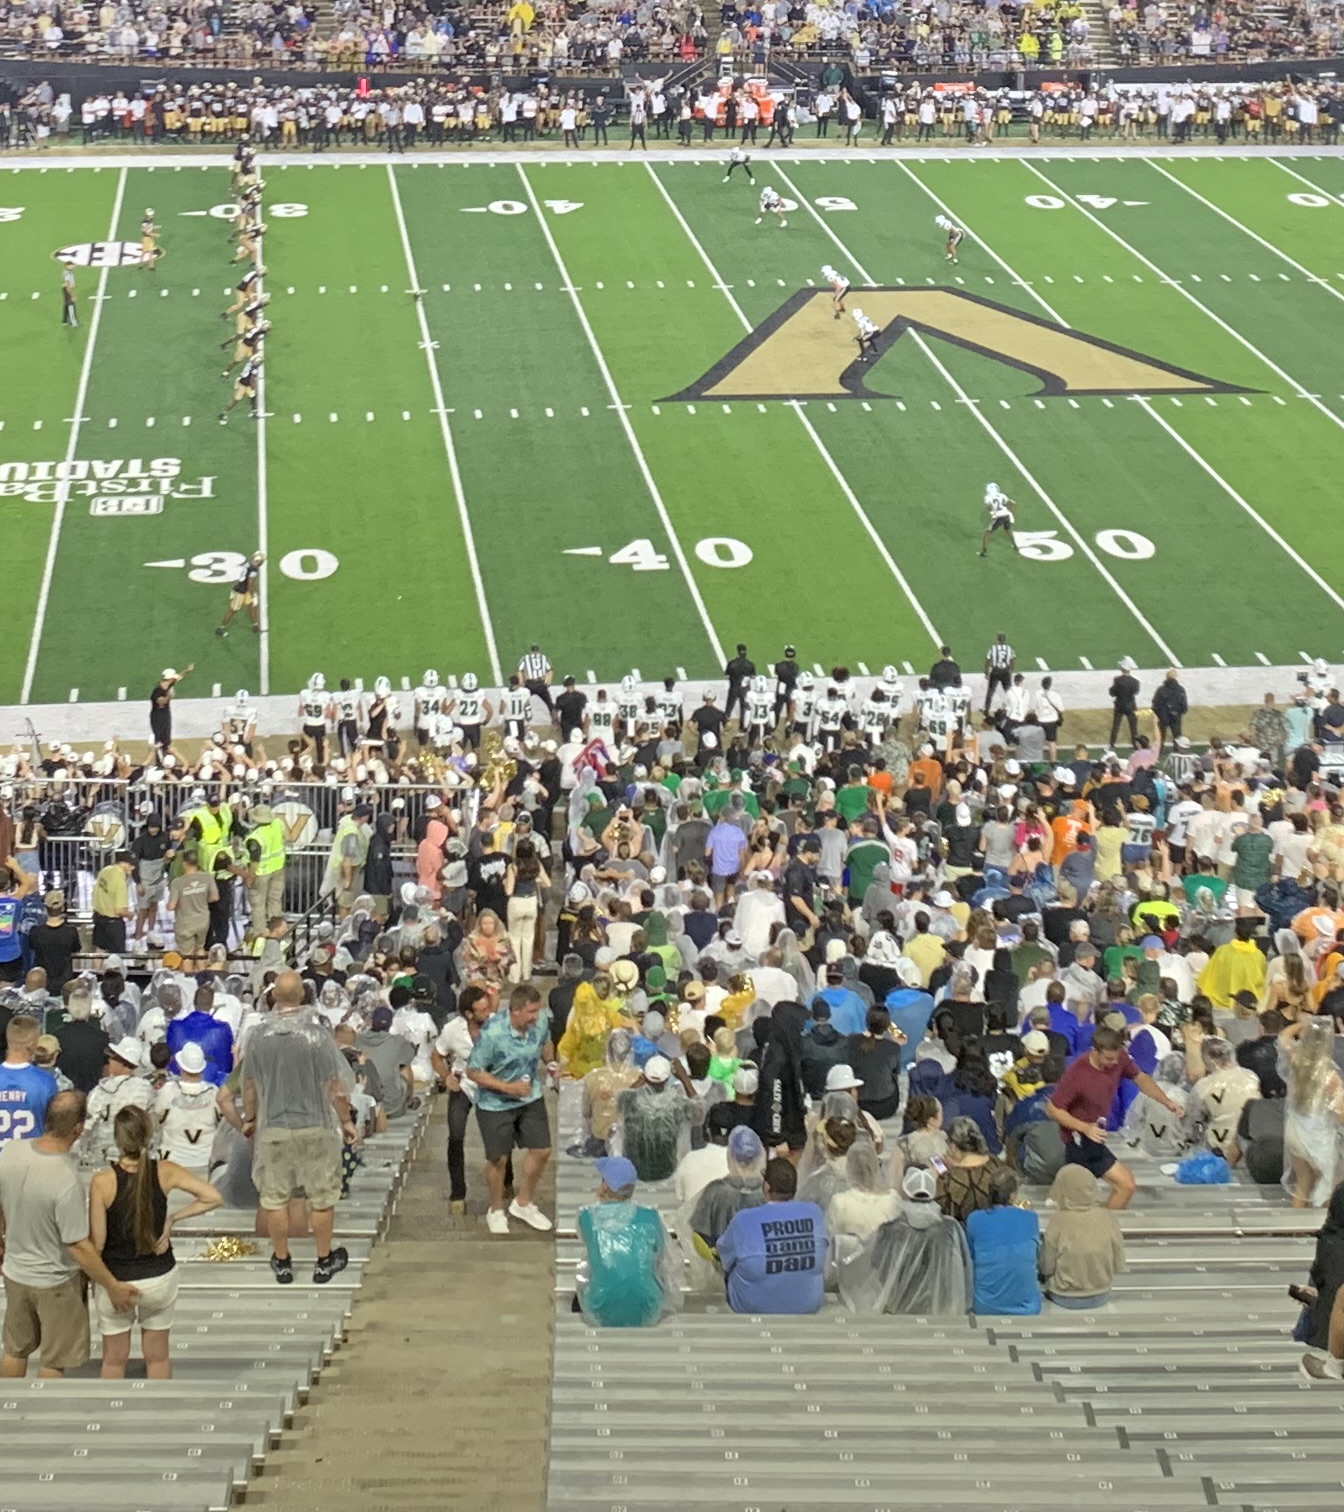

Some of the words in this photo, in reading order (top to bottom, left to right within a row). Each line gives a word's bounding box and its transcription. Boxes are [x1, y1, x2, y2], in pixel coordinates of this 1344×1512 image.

[487, 199, 584, 216] 40
[1025, 194, 1123, 211] 40
[1017, 529, 1156, 561] 50
[609, 537, 754, 571] 40
[187, 550, 339, 584] 30
[460, 700, 478, 716] 22
[511, 700, 523, 715] 11
[755, 704, 767, 718] 13
[184, 1129, 202, 1144] V
[761, 1217, 814, 1238] PROUD
